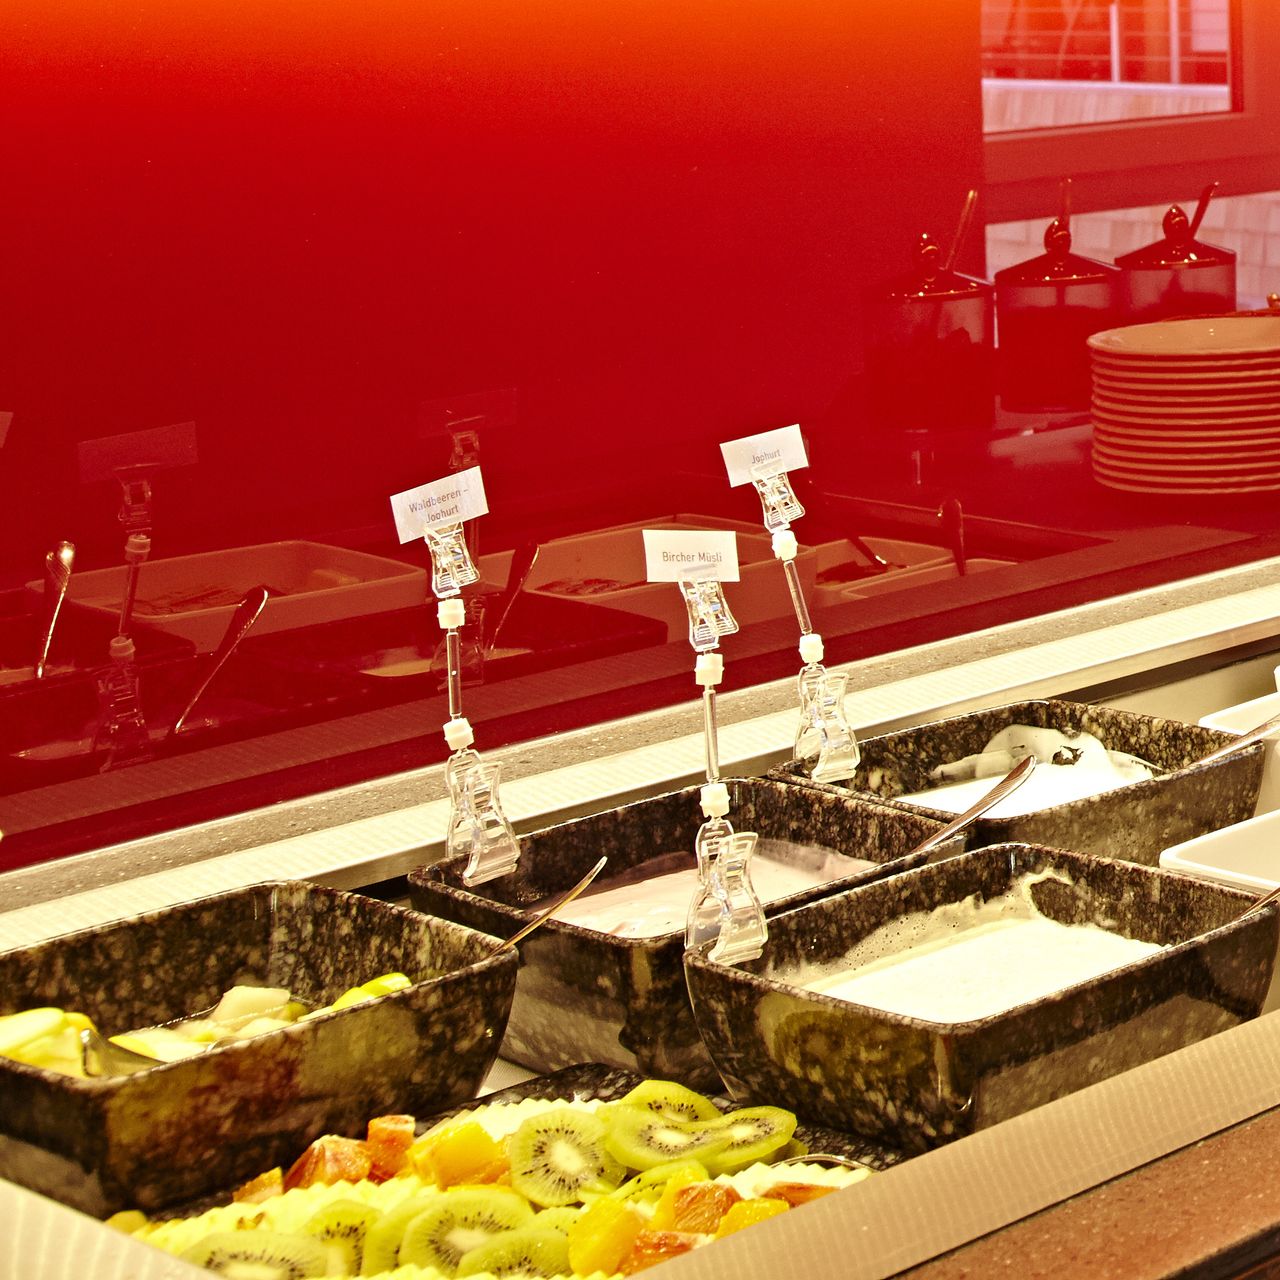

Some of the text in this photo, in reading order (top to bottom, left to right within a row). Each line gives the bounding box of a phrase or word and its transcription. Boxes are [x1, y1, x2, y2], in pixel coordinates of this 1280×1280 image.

[408, 489, 462, 513] Waldbeeren
[662, 551, 723, 563] Bircher Müsli
